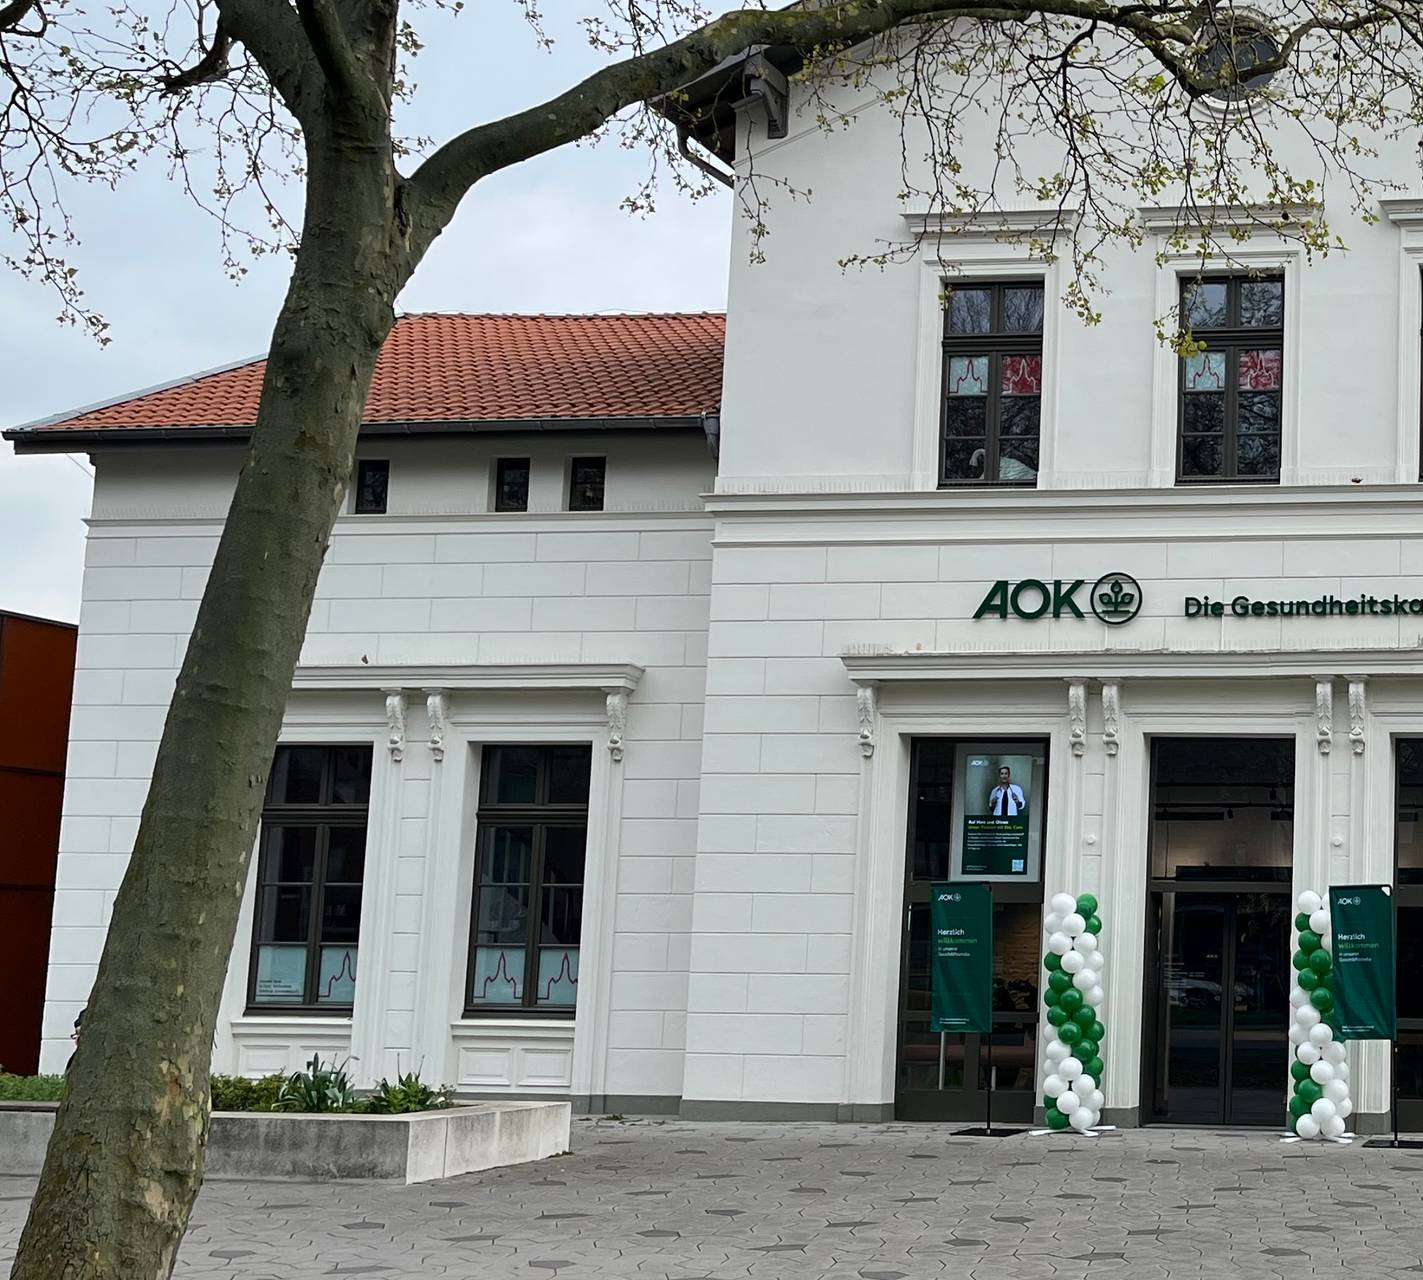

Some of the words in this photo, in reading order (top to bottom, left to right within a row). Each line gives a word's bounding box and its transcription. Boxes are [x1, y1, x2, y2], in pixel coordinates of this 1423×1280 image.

[972, 579, 1085, 619] AOK
[1185, 595, 1224, 617] Die
[1338, 933, 1366, 941] Herzlich
